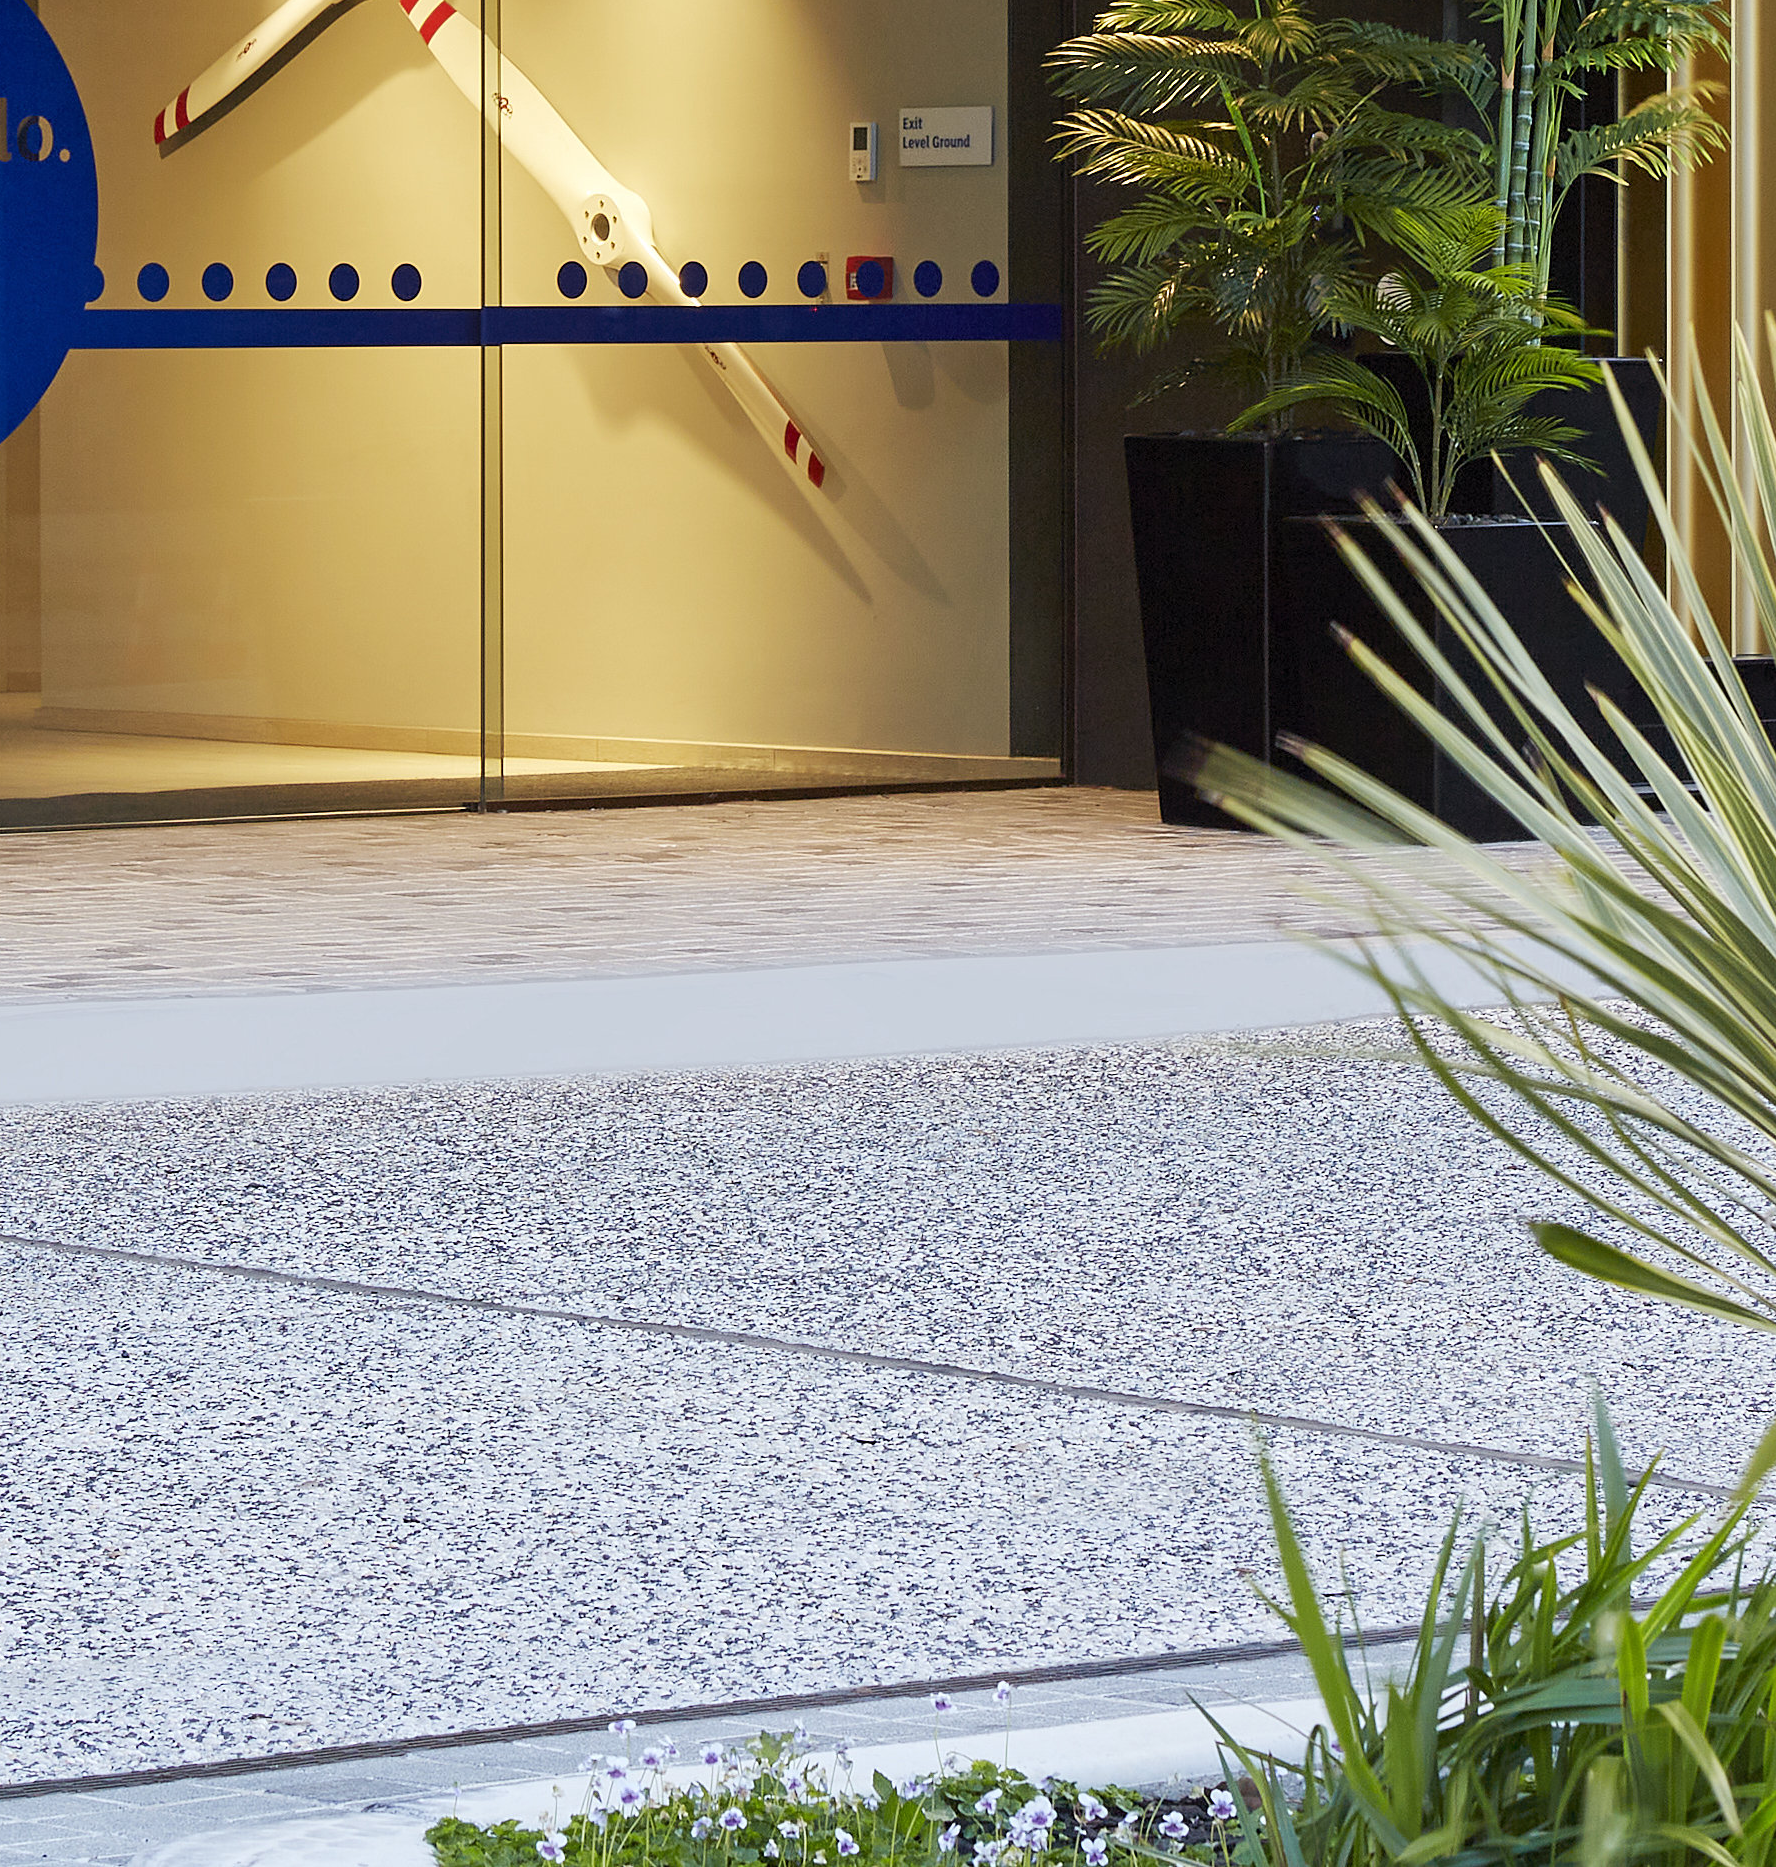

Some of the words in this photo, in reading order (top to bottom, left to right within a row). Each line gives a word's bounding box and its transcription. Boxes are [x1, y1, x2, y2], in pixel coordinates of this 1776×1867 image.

[902, 116, 923, 130] Exit
[902, 135, 930, 149] Level
[932, 134, 971, 149] Ground
